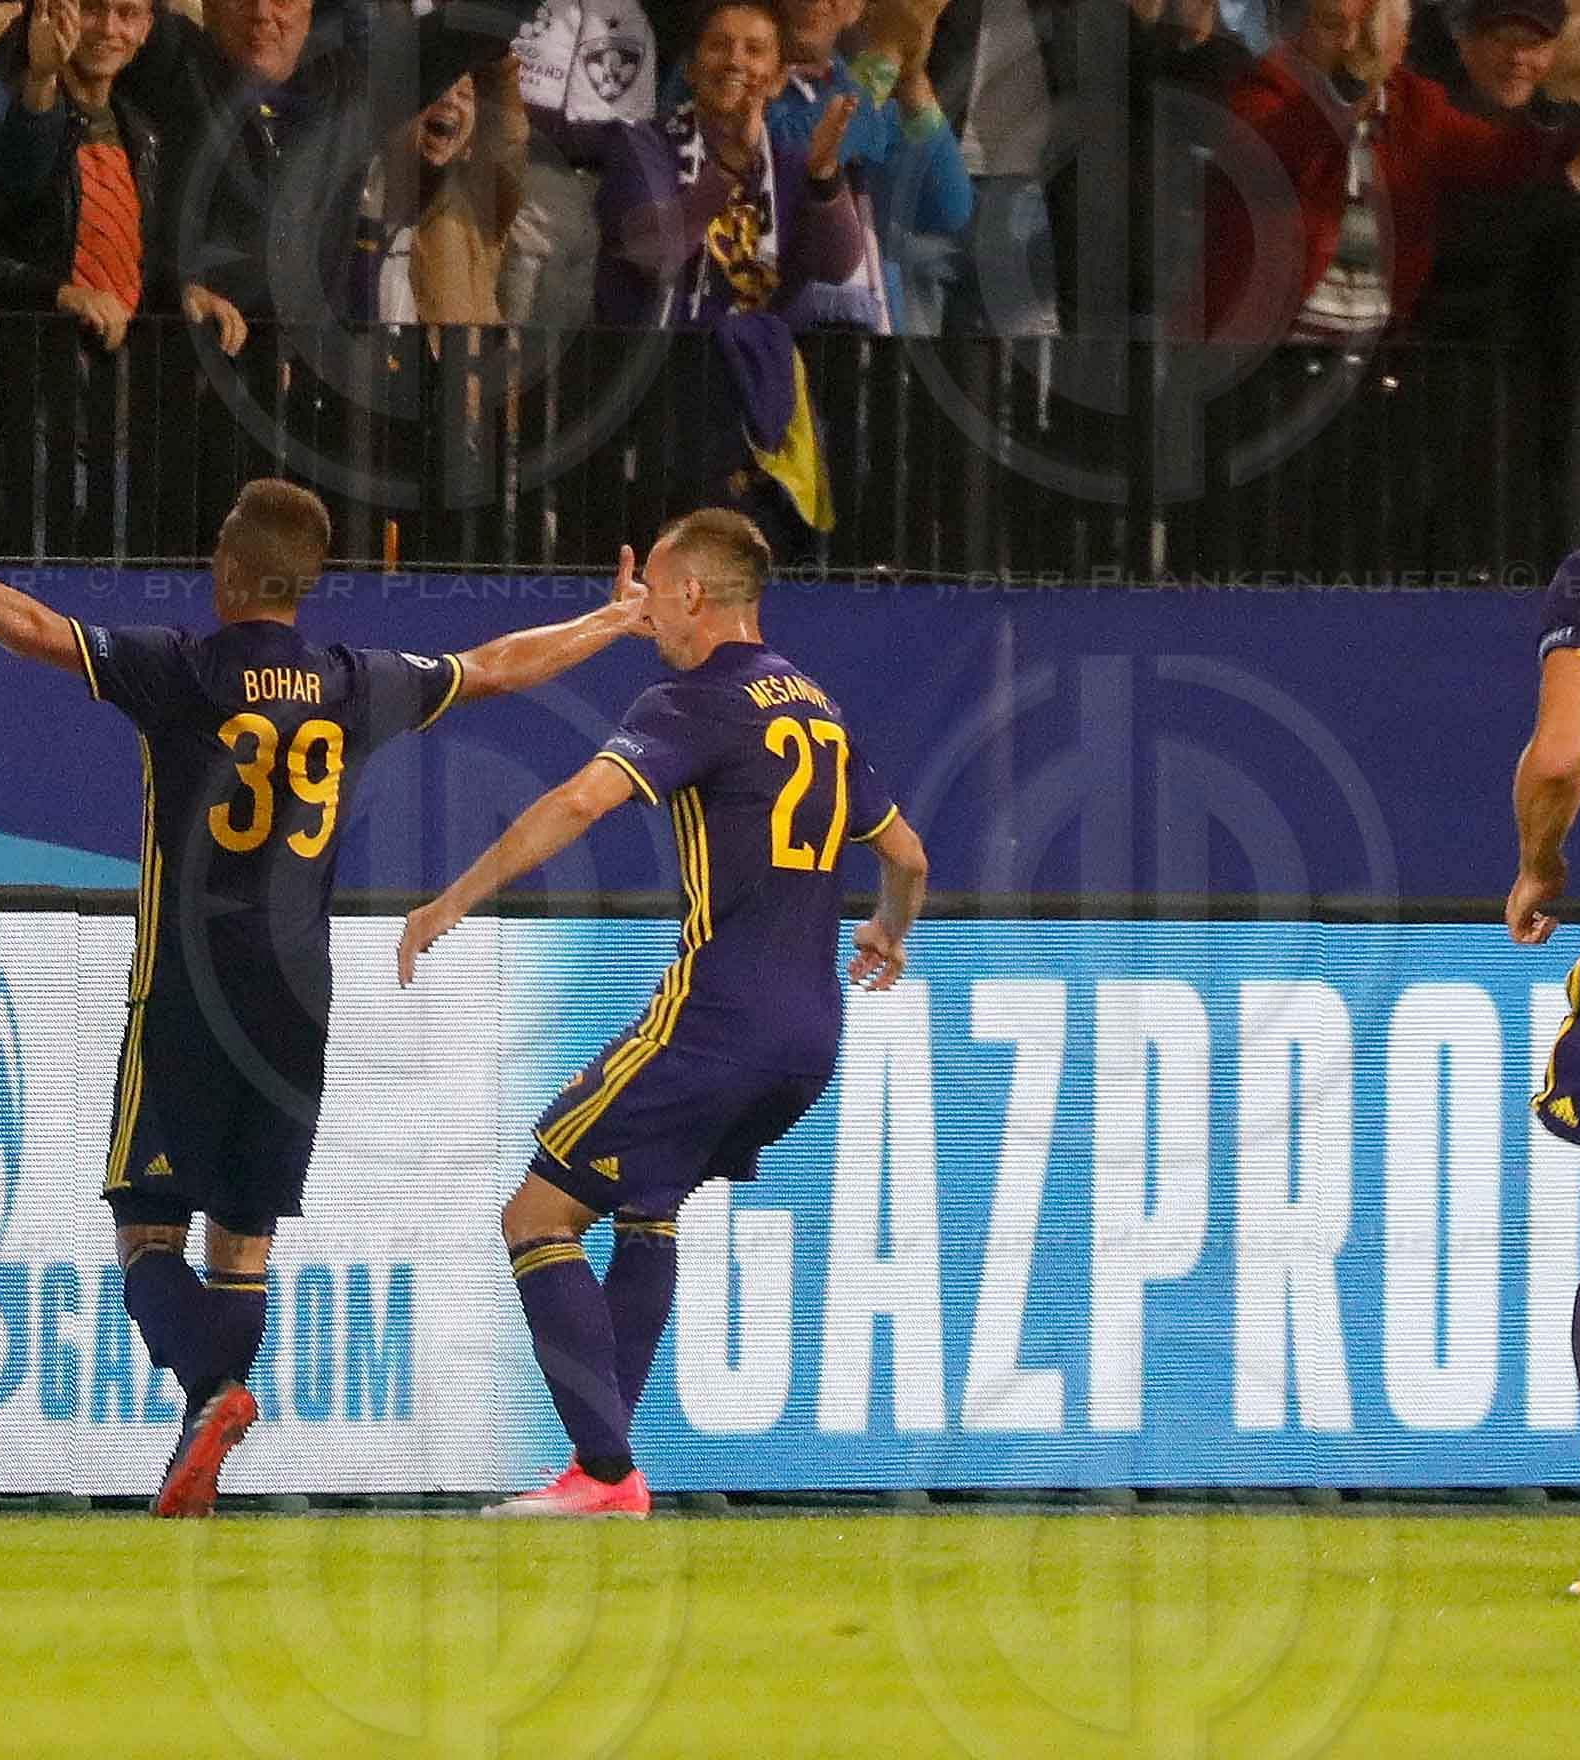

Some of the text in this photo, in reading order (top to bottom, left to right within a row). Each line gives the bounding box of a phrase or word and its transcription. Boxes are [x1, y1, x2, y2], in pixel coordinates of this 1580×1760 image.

[243, 668, 321, 705] BOHAR
[207, 712, 345, 860] 39
[764, 715, 851, 873] 27
[38, 1261, 415, 1424] GAOM
